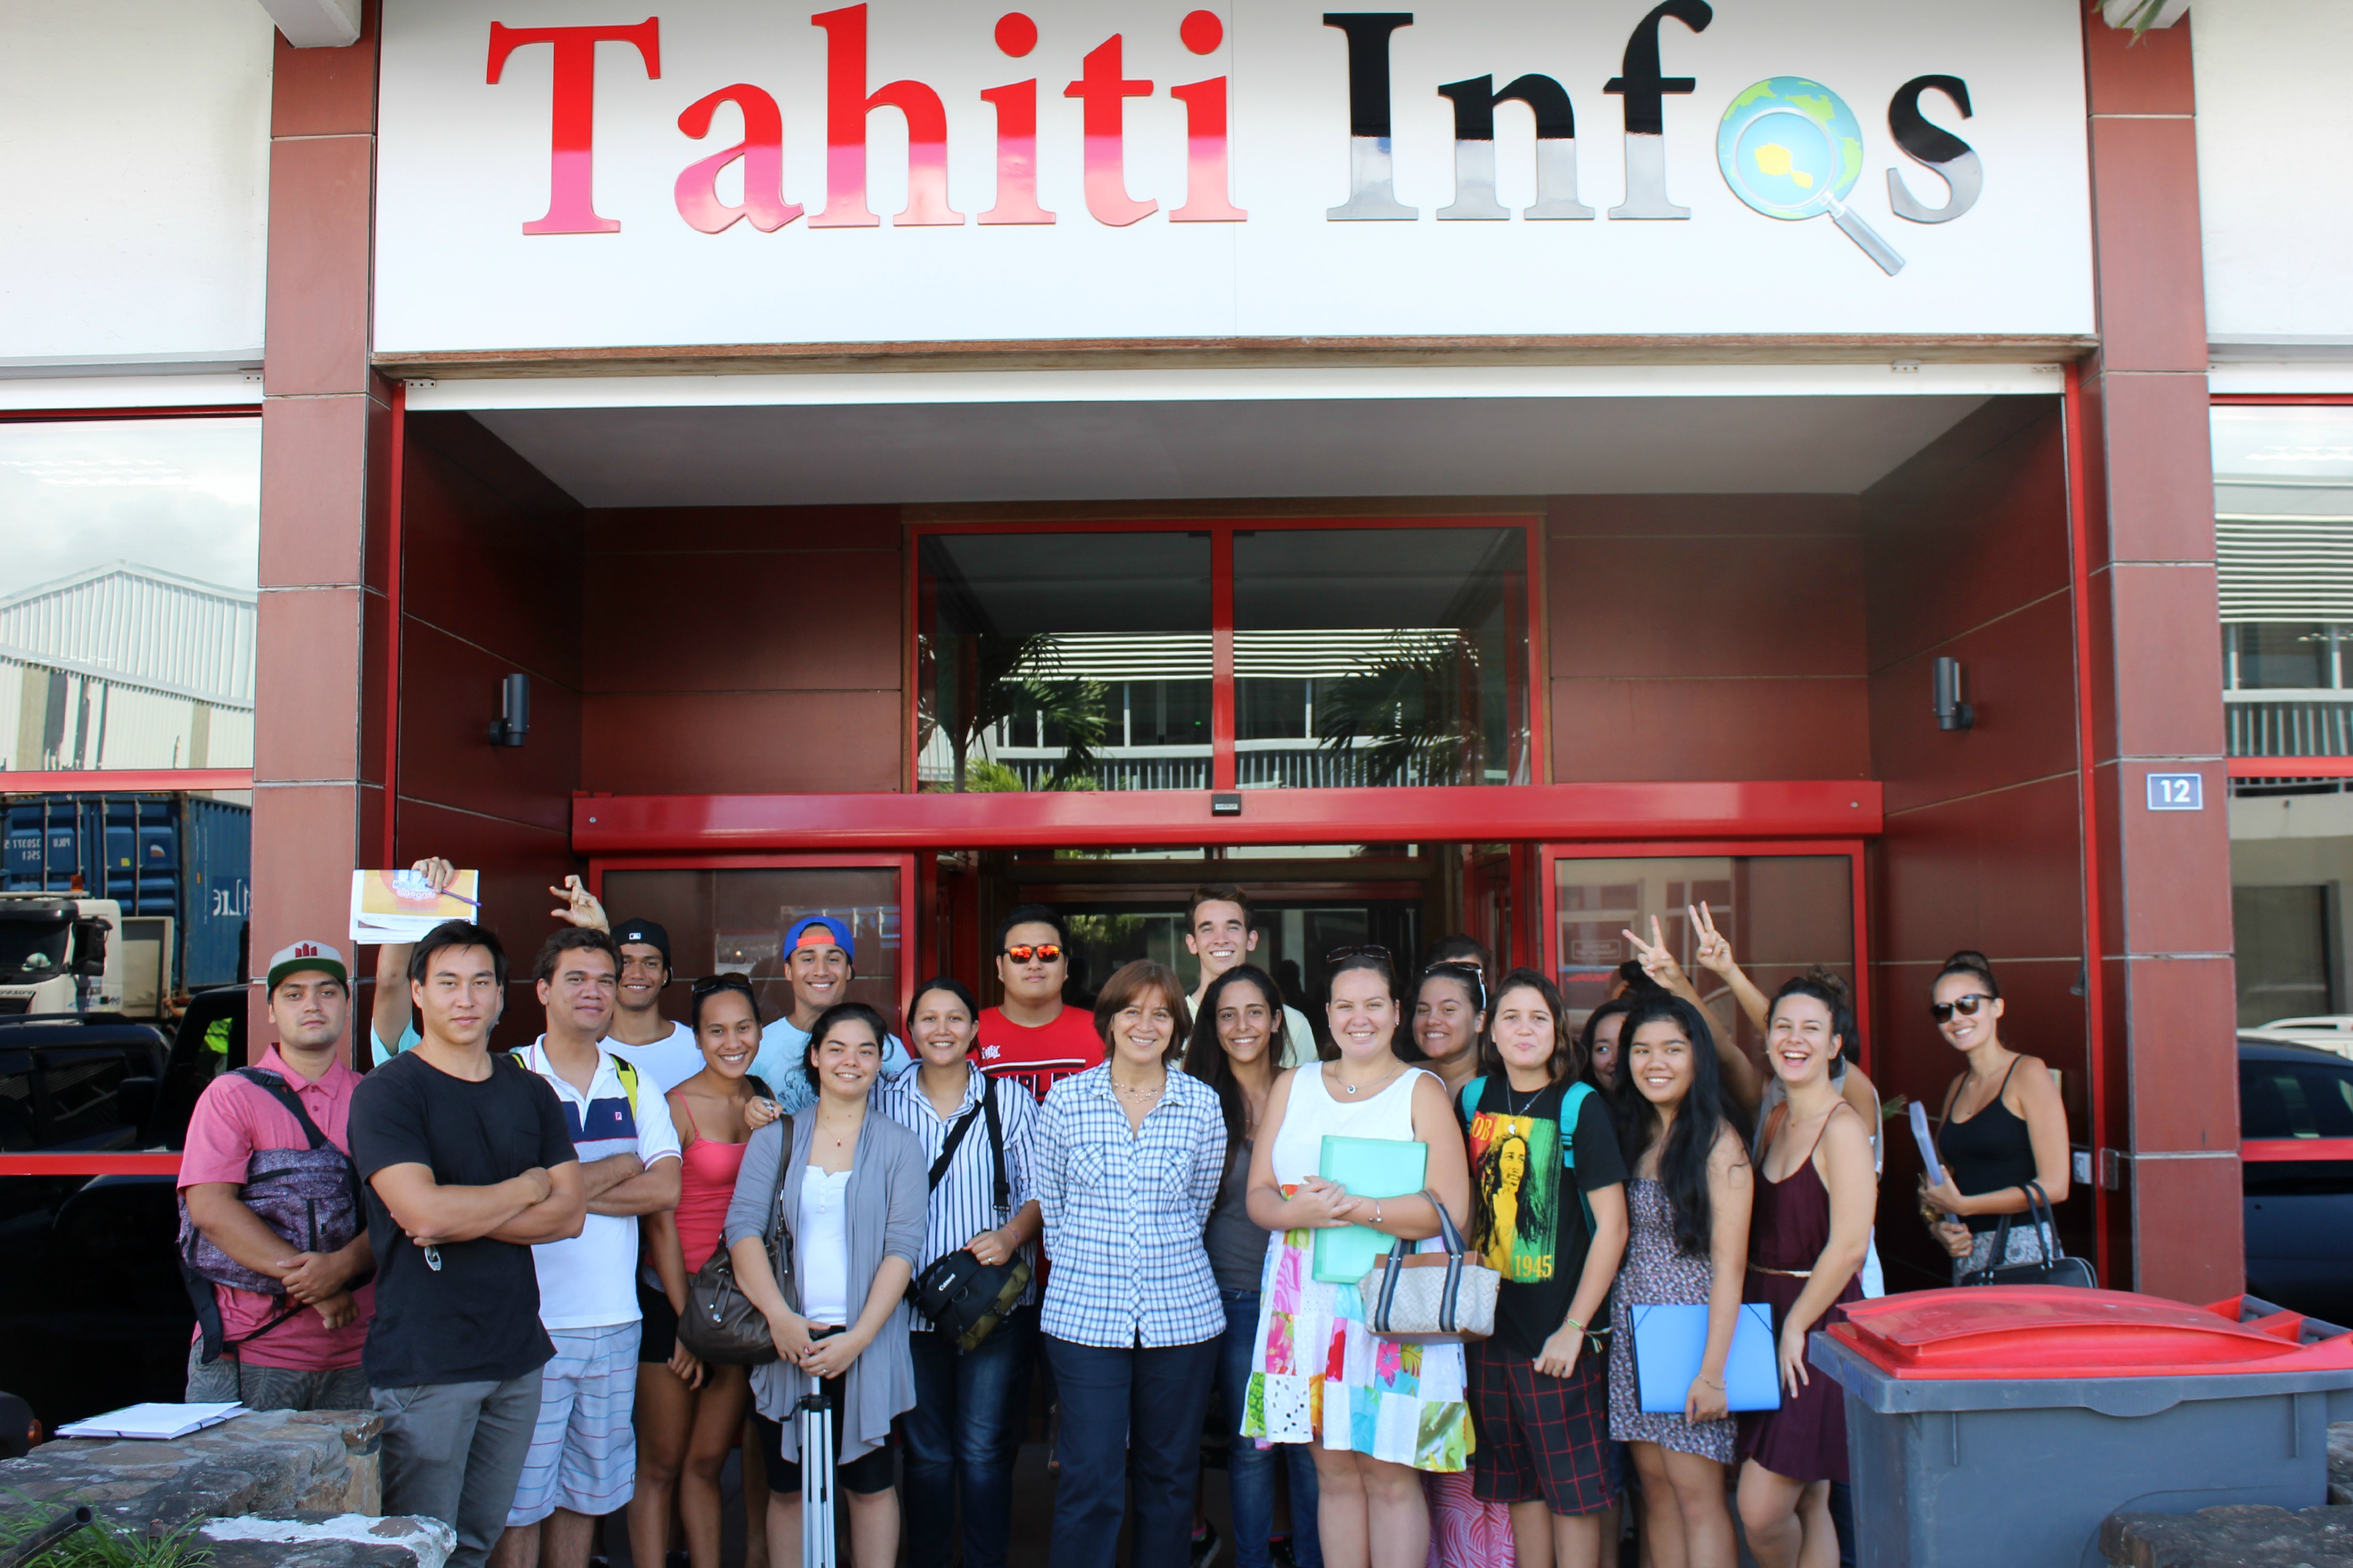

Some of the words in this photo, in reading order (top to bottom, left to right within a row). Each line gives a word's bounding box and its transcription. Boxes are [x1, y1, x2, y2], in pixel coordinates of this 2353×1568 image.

[486, 2, 1248, 235] Tahiti
[2159, 779, 2190, 803] 12
[393, 880, 426, 890] Milliard
[1470, 1116, 1493, 1141] OB
[1515, 1255, 1553, 1278] 1945
